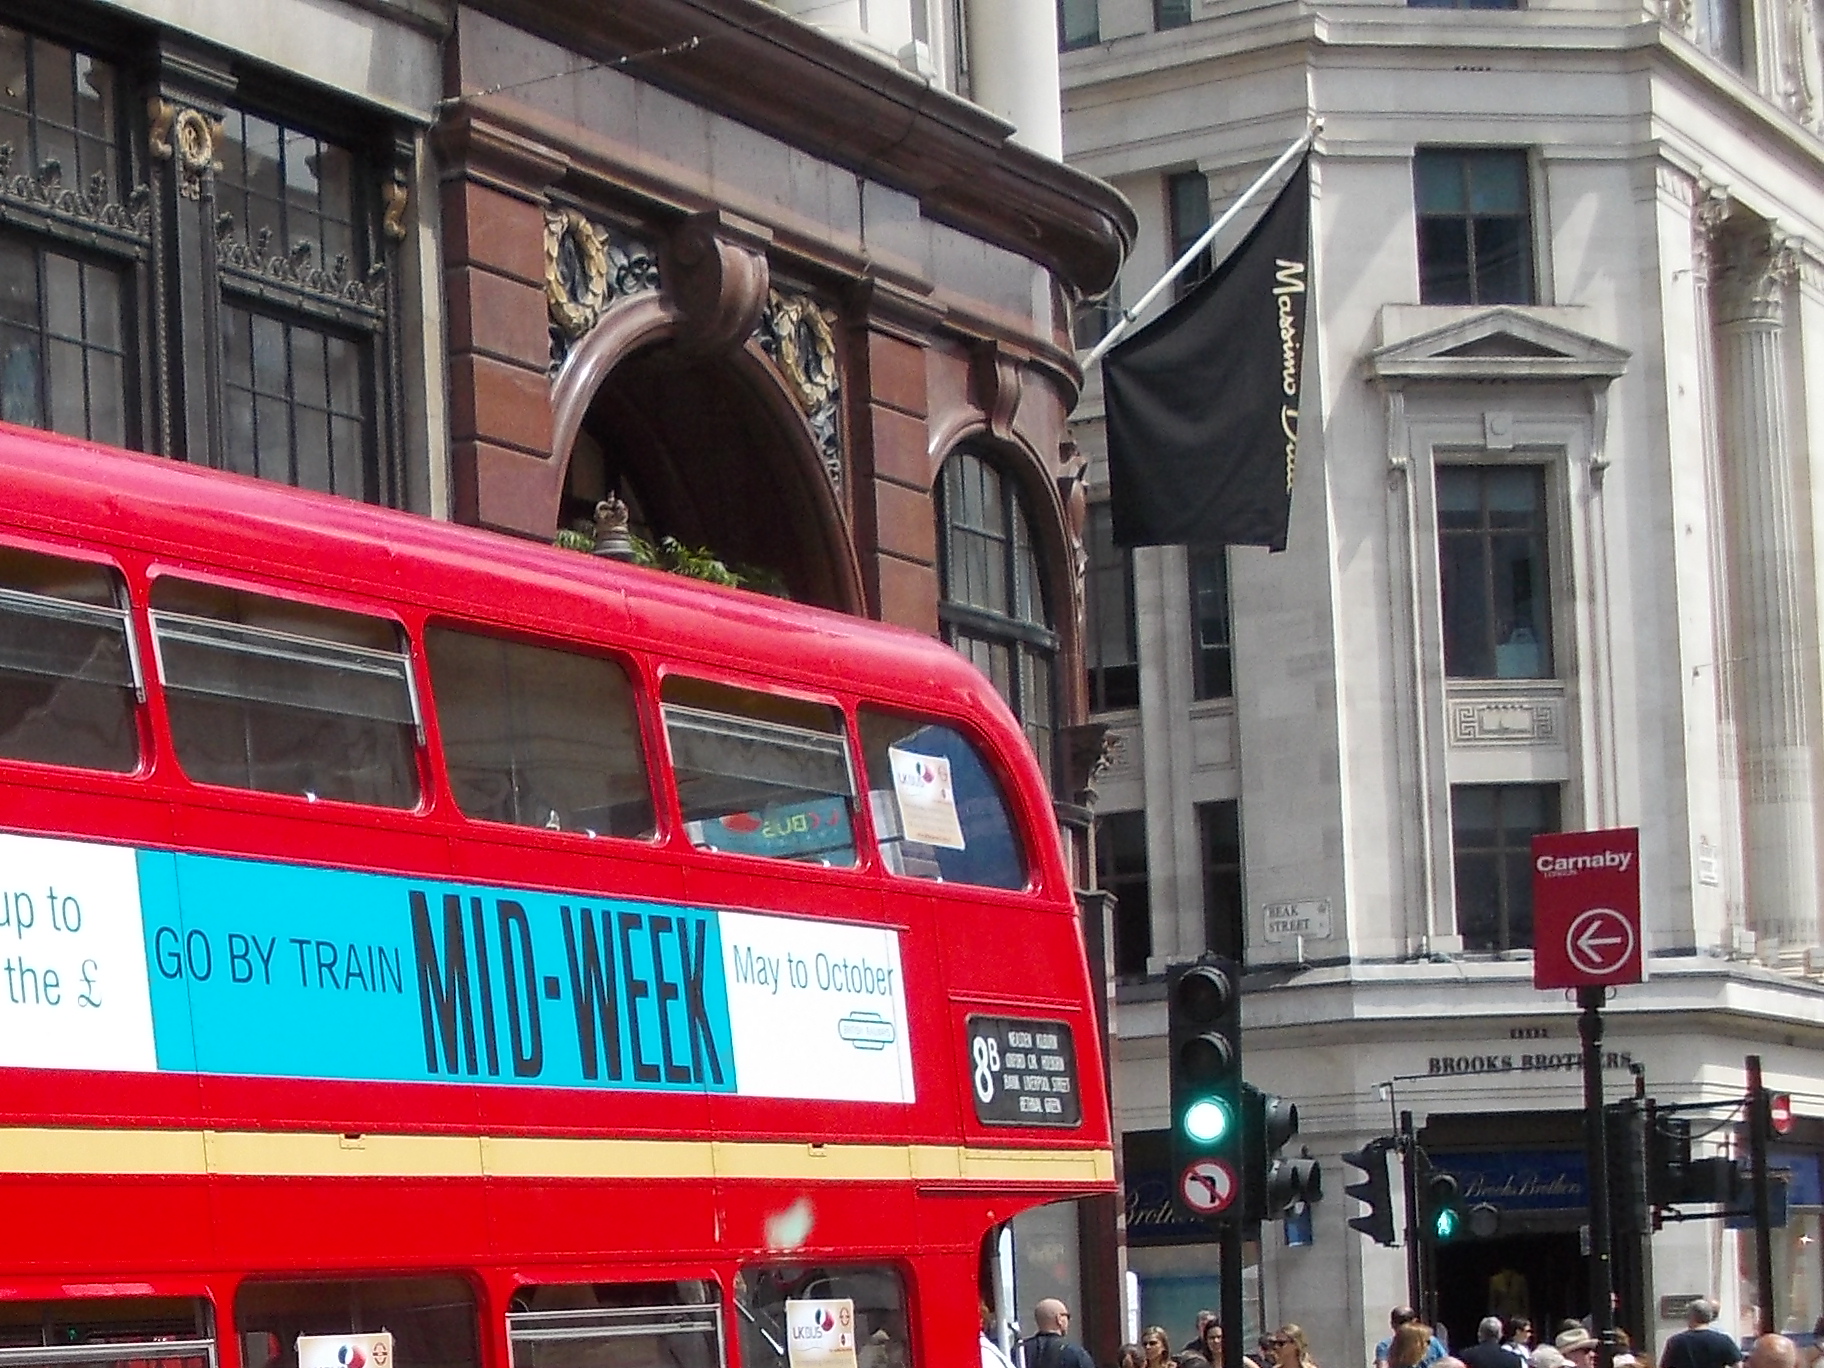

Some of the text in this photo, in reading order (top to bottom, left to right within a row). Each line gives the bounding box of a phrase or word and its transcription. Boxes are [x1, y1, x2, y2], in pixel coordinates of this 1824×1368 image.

[1273, 258, 1305, 396] Massimo
[1536, 850, 1633, 872] Carnaby
[48, 885, 82, 933] to
[1267, 905, 1298, 918] BEAK
[1269, 918, 1309, 932] STREET
[3, 955, 61, 1007] the
[77, 958, 102, 1008] £
[154, 926, 404, 995] GO BY TRAIN
[733, 943, 894, 997] May to October
[408, 889, 724, 1086] MID-WEEK
[1428, 1051, 1632, 1074] BROOKS BROTRS
